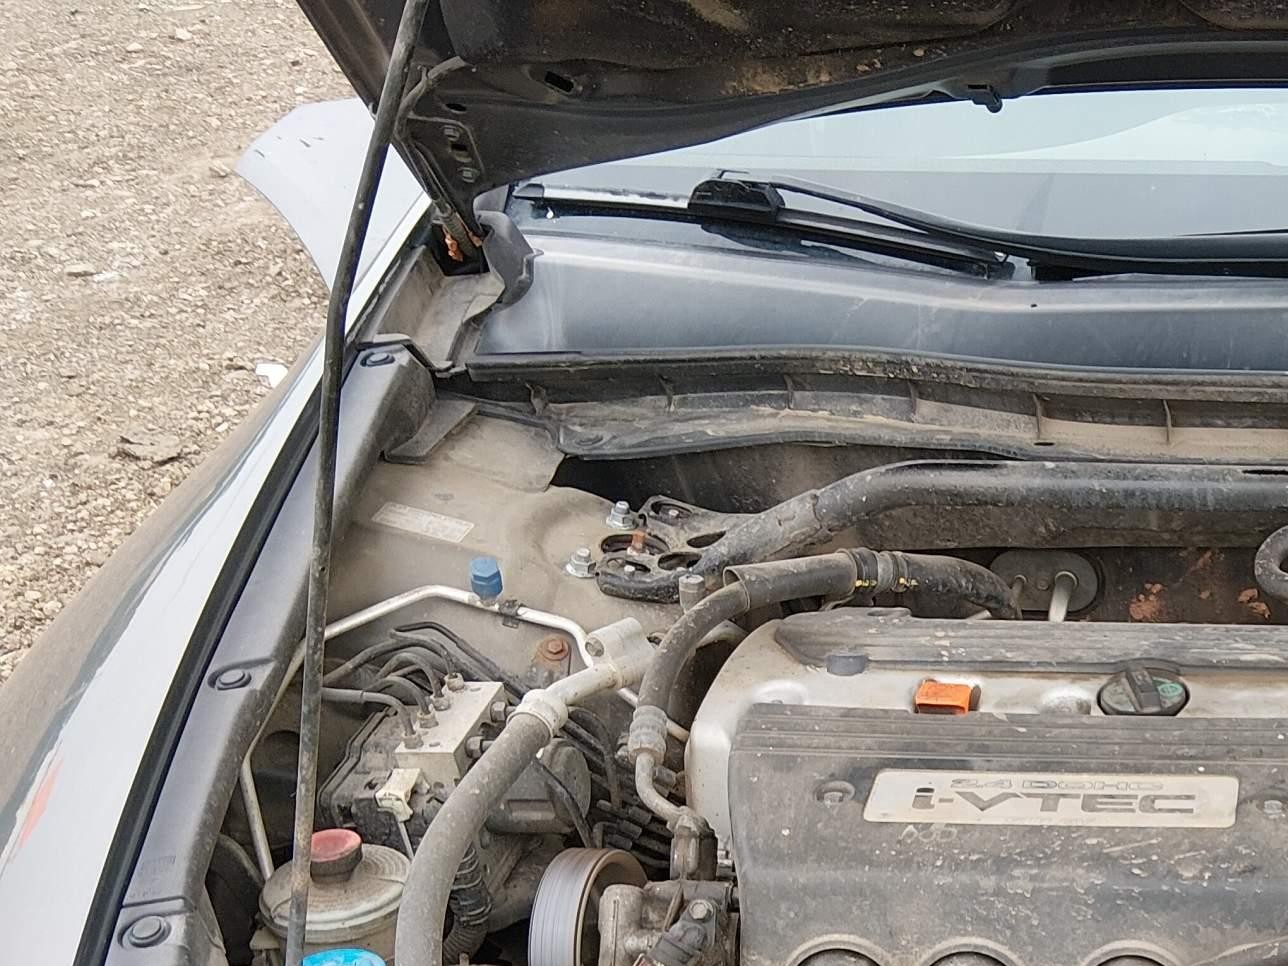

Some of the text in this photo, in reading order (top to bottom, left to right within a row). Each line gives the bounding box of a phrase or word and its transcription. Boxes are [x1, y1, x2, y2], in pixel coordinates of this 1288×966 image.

[951, 779, 1163, 791] 2.4 DOHC
[912, 786, 1196, 815] i-VTEC
